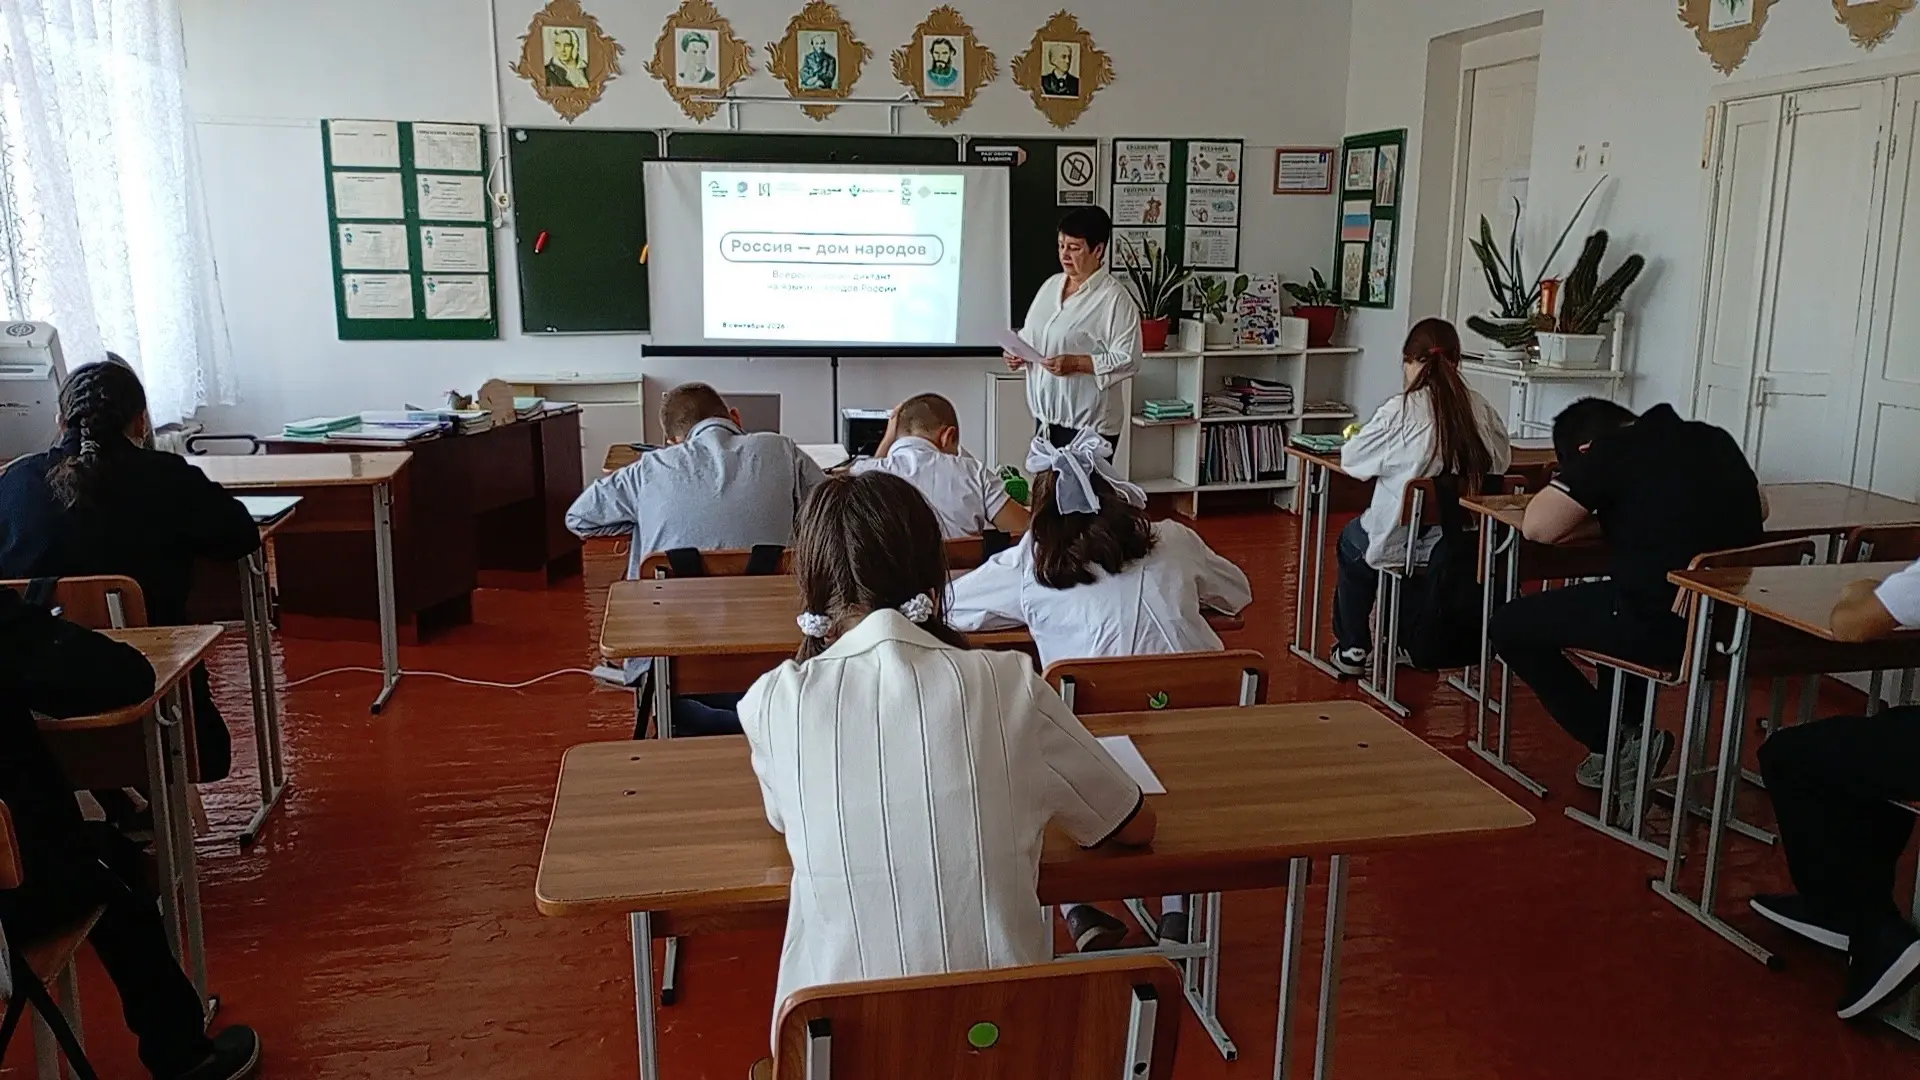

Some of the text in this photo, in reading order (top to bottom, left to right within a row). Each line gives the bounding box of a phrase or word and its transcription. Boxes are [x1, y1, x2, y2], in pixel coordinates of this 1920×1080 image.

[731, 239, 792, 253] Россия
[816, 245, 849, 256] дом
[855, 245, 926, 257] народов
[853, 273, 891, 281] диктант
[823, 284, 858, 292] родов
[861, 284, 897, 293] России
